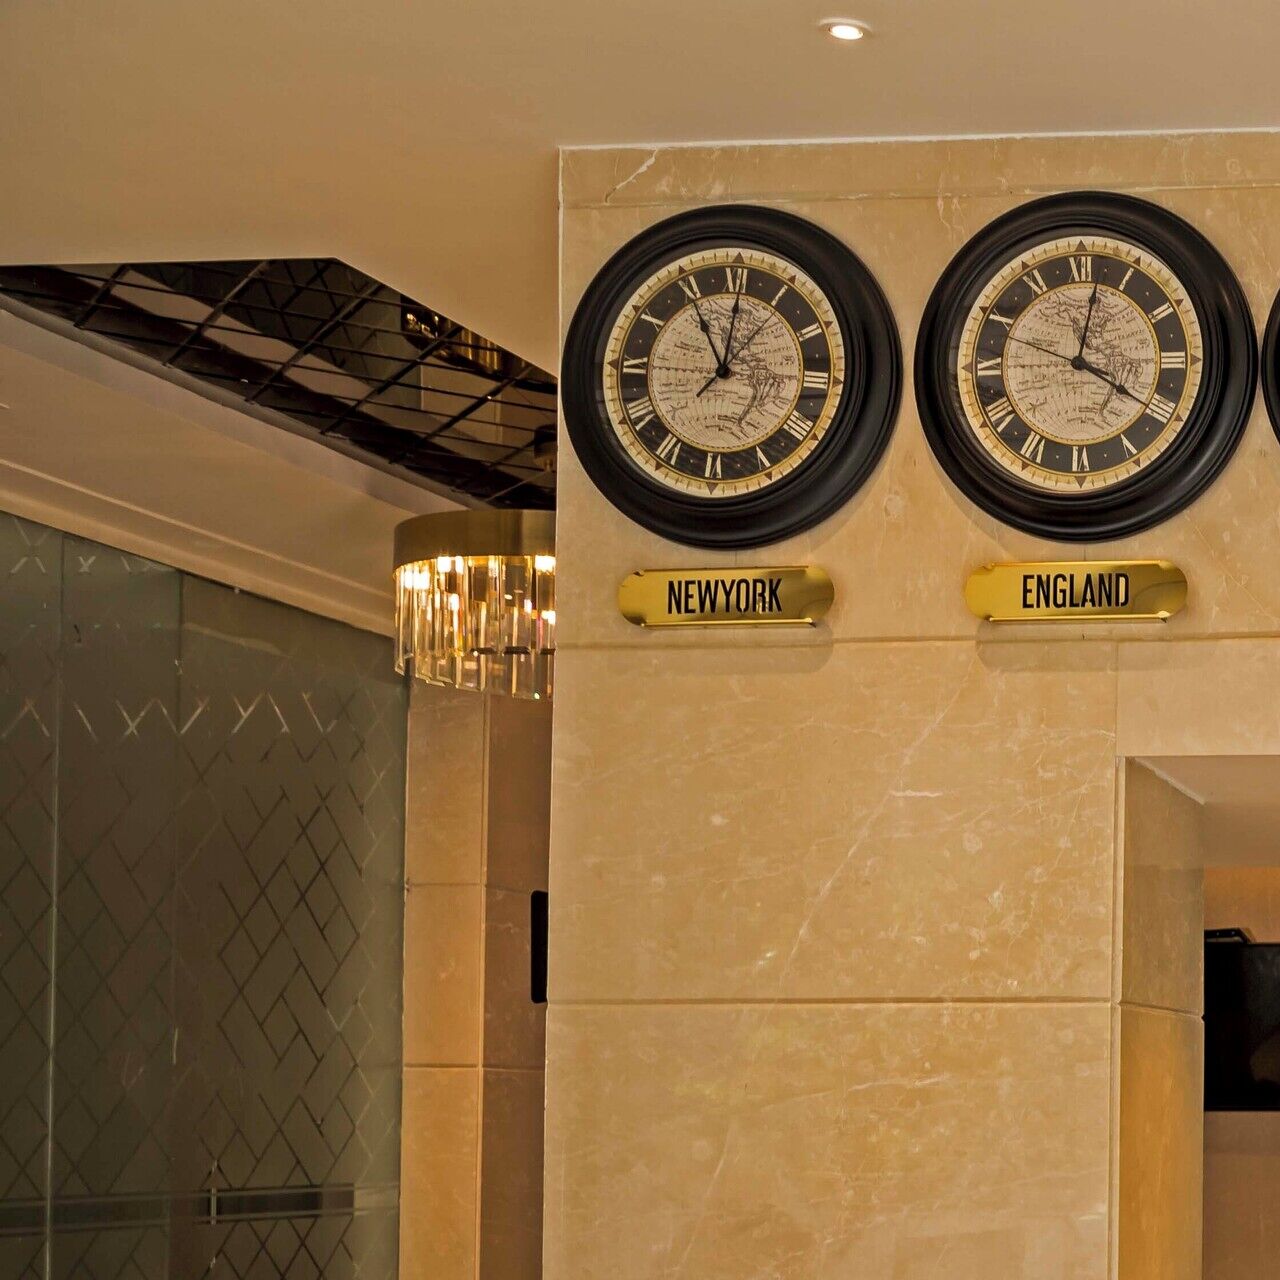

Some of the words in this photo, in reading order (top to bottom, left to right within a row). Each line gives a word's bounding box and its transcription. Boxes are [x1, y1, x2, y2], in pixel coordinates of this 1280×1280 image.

[1069, 256, 1091, 282] XII
[1119, 268, 1134, 290] I
[726, 268, 747, 293] XII
[771, 285, 788, 306] I
[641, 309, 664, 332] X
[989, 308, 1013, 330] X
[1151, 303, 1174, 324] II
[797, 323, 822, 341] II
[1161, 353, 1185, 368] III
[804, 372, 828, 389] III
[667, 578, 782, 614] NEWYORK
[1022, 572, 1129, 608] ENGLAND
